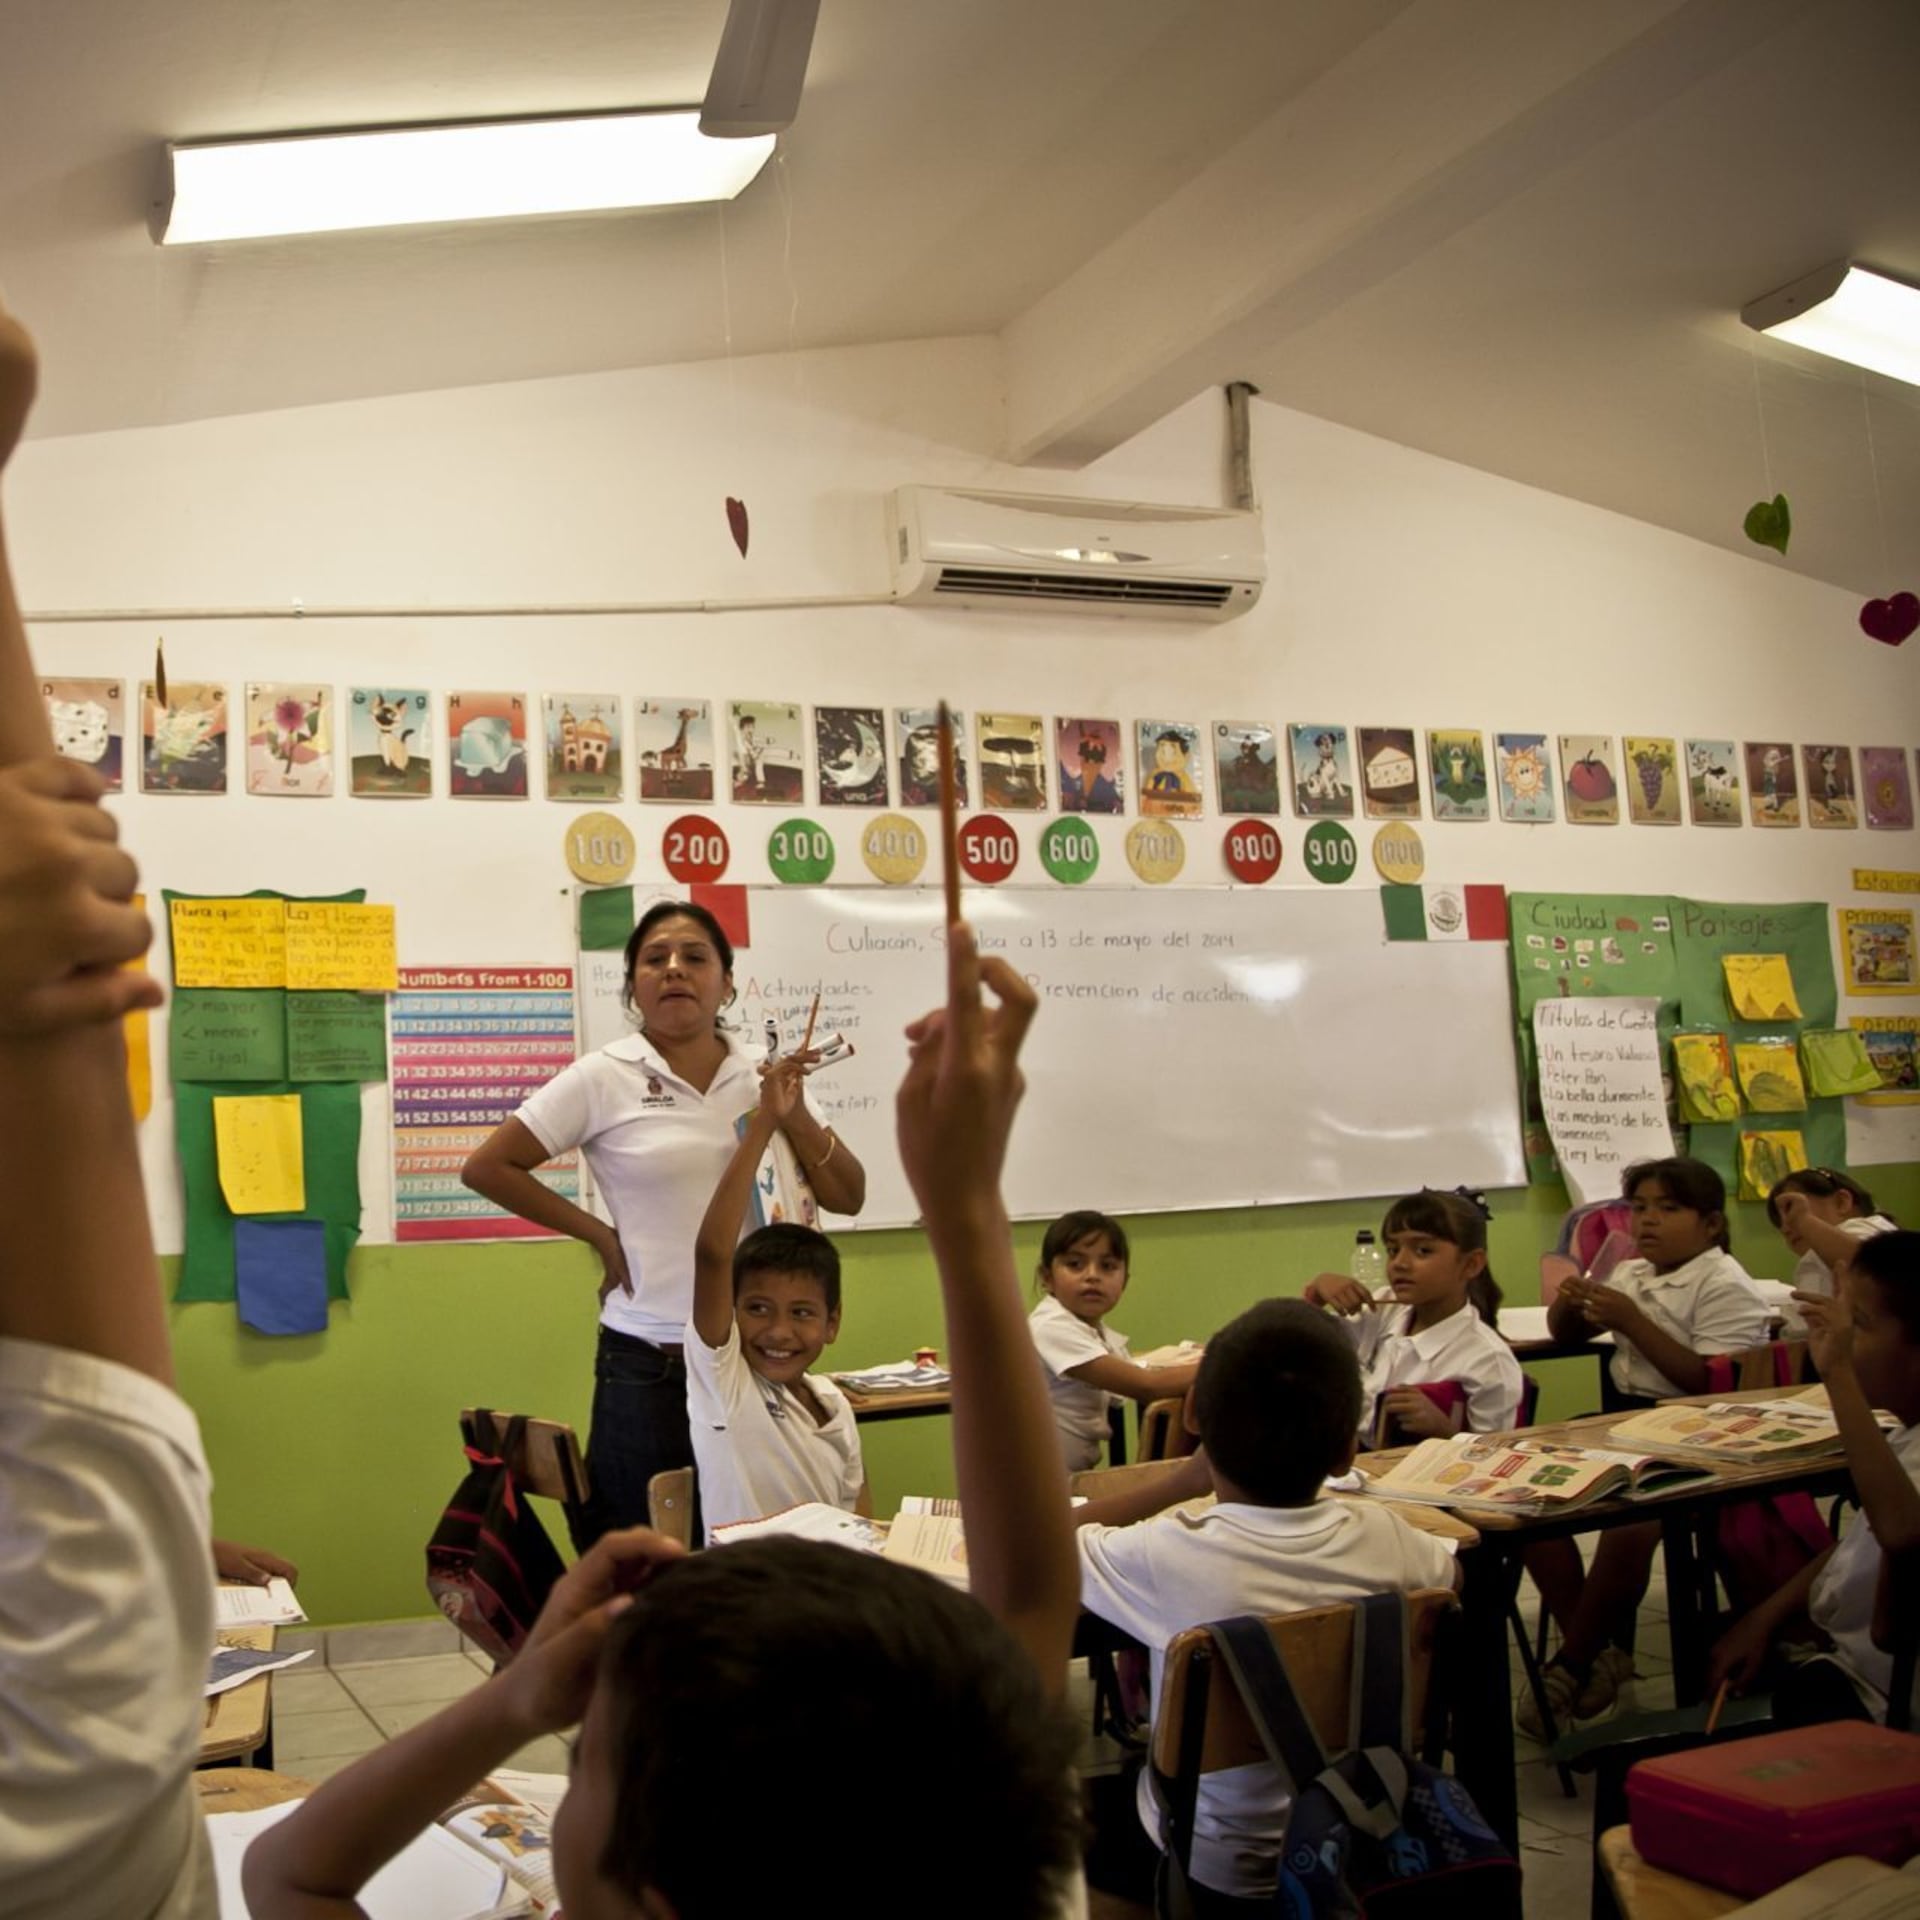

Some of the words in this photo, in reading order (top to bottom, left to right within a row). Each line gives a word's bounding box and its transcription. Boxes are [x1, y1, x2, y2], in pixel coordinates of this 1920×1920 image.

[574, 832, 627, 866] 100
[668, 831, 725, 866] 200
[773, 831, 828, 862] 300
[868, 833, 919, 859] 400
[966, 835, 1015, 865] 500
[1049, 835, 1094, 863] 600
[1133, 832, 1177, 863] 700
[1230, 833, 1277, 862] 800
[1308, 840, 1354, 865] 900
[1531, 900, 1608, 931] Ciudad
[1684, 904, 1790, 947] Paisajes
[929, 925, 1007, 950] Sloa
[1019, 935, 1033, 948] a
[1040, 929, 1057, 948] 13
[1069, 929, 1095, 948] de
[1104, 935, 1151, 951] mayo
[1162, 931, 1190, 948] del
[480, 973, 520, 986] From
[523, 973, 566, 987] 1-100
[743, 976, 873, 1001] Actividades
[1152, 984, 1176, 1002] de
[1596, 1008, 1616, 1030] de
[1544, 1043, 1564, 1062] Un
[1571, 1040, 1614, 1062] tesoro
[1547, 1064, 1579, 1084] Peter
[1585, 1067, 1607, 1085] Pan
[1566, 1087, 1595, 1102] bella
[395, 1111, 409, 1123] 51
[413, 1110, 430, 1122] 52
[432, 1110, 448, 1122] 53
[450, 1110, 467, 1122] 54
[469, 1110, 485, 1122] 55
[487, 1110, 503, 1122] 56
[1621, 1109, 1639, 1128] de
[1641, 1110, 1664, 1129] los
